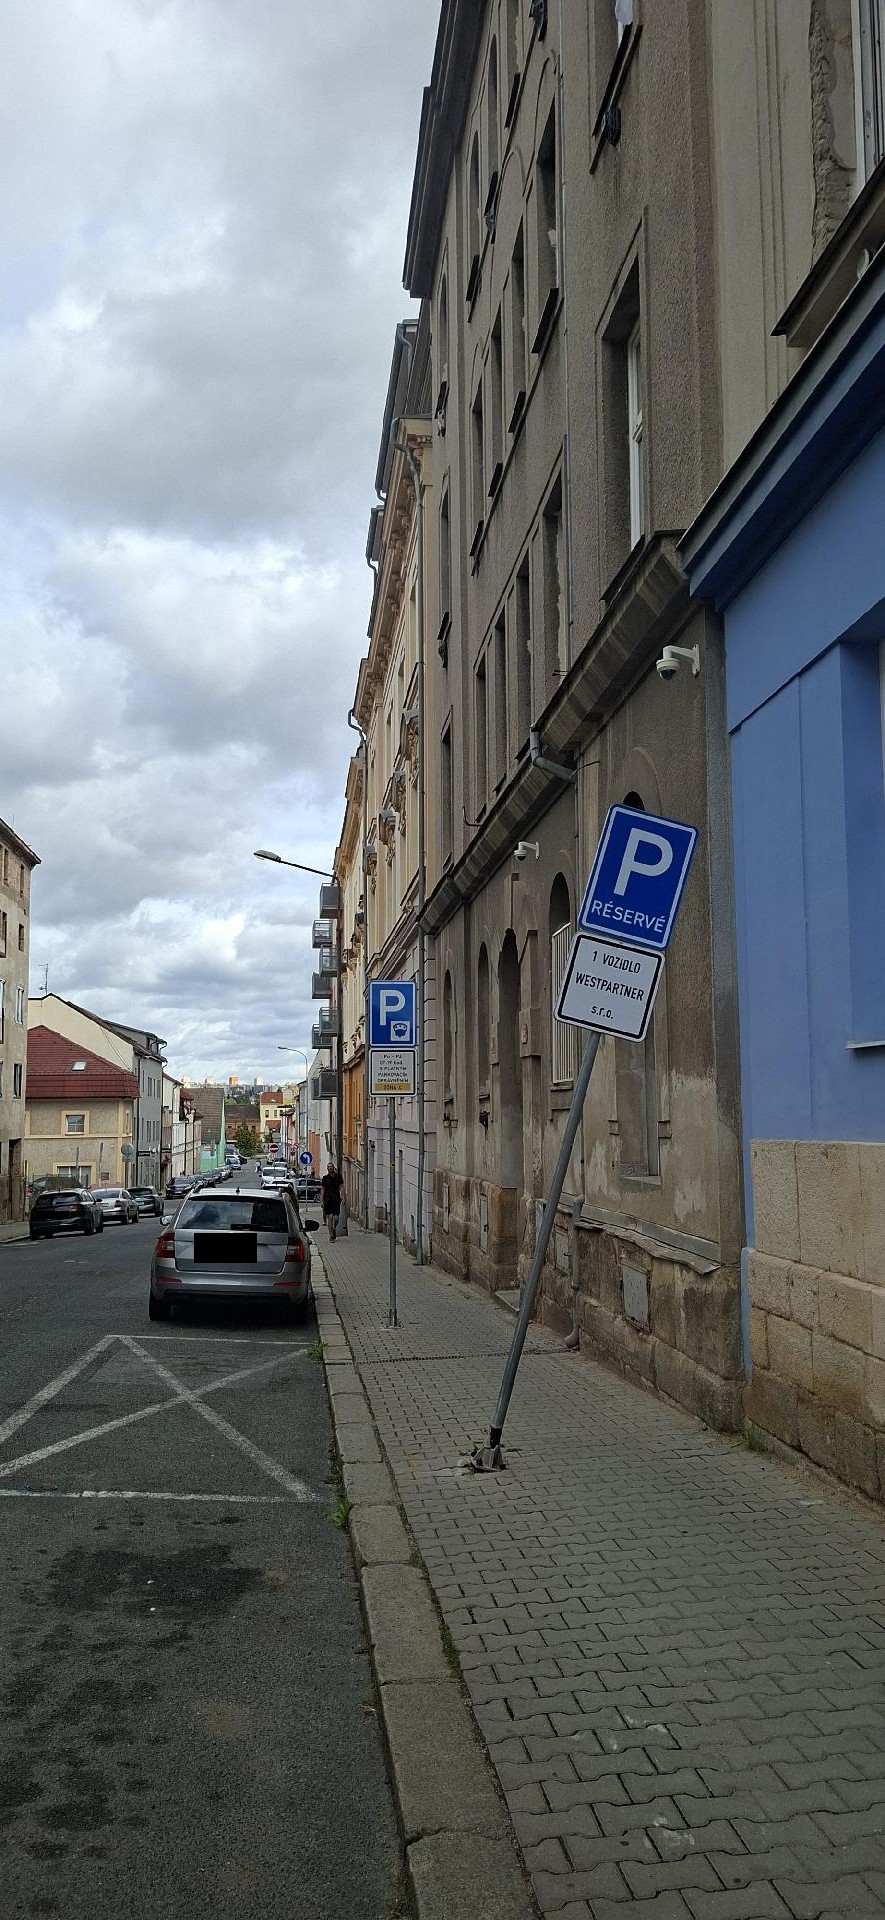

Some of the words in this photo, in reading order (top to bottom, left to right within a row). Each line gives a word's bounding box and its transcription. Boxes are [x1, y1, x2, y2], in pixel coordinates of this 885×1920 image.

[613, 827, 674, 896] P
[591, 900, 666, 933] RÉSERVÉ
[592, 951, 598, 962] 1
[602, 953, 641, 974] VOZIDLO
[574, 971, 645, 1001] WESTPARTNER
[379, 989, 406, 1026] P
[590, 1005, 614, 1020] s.r.o.
